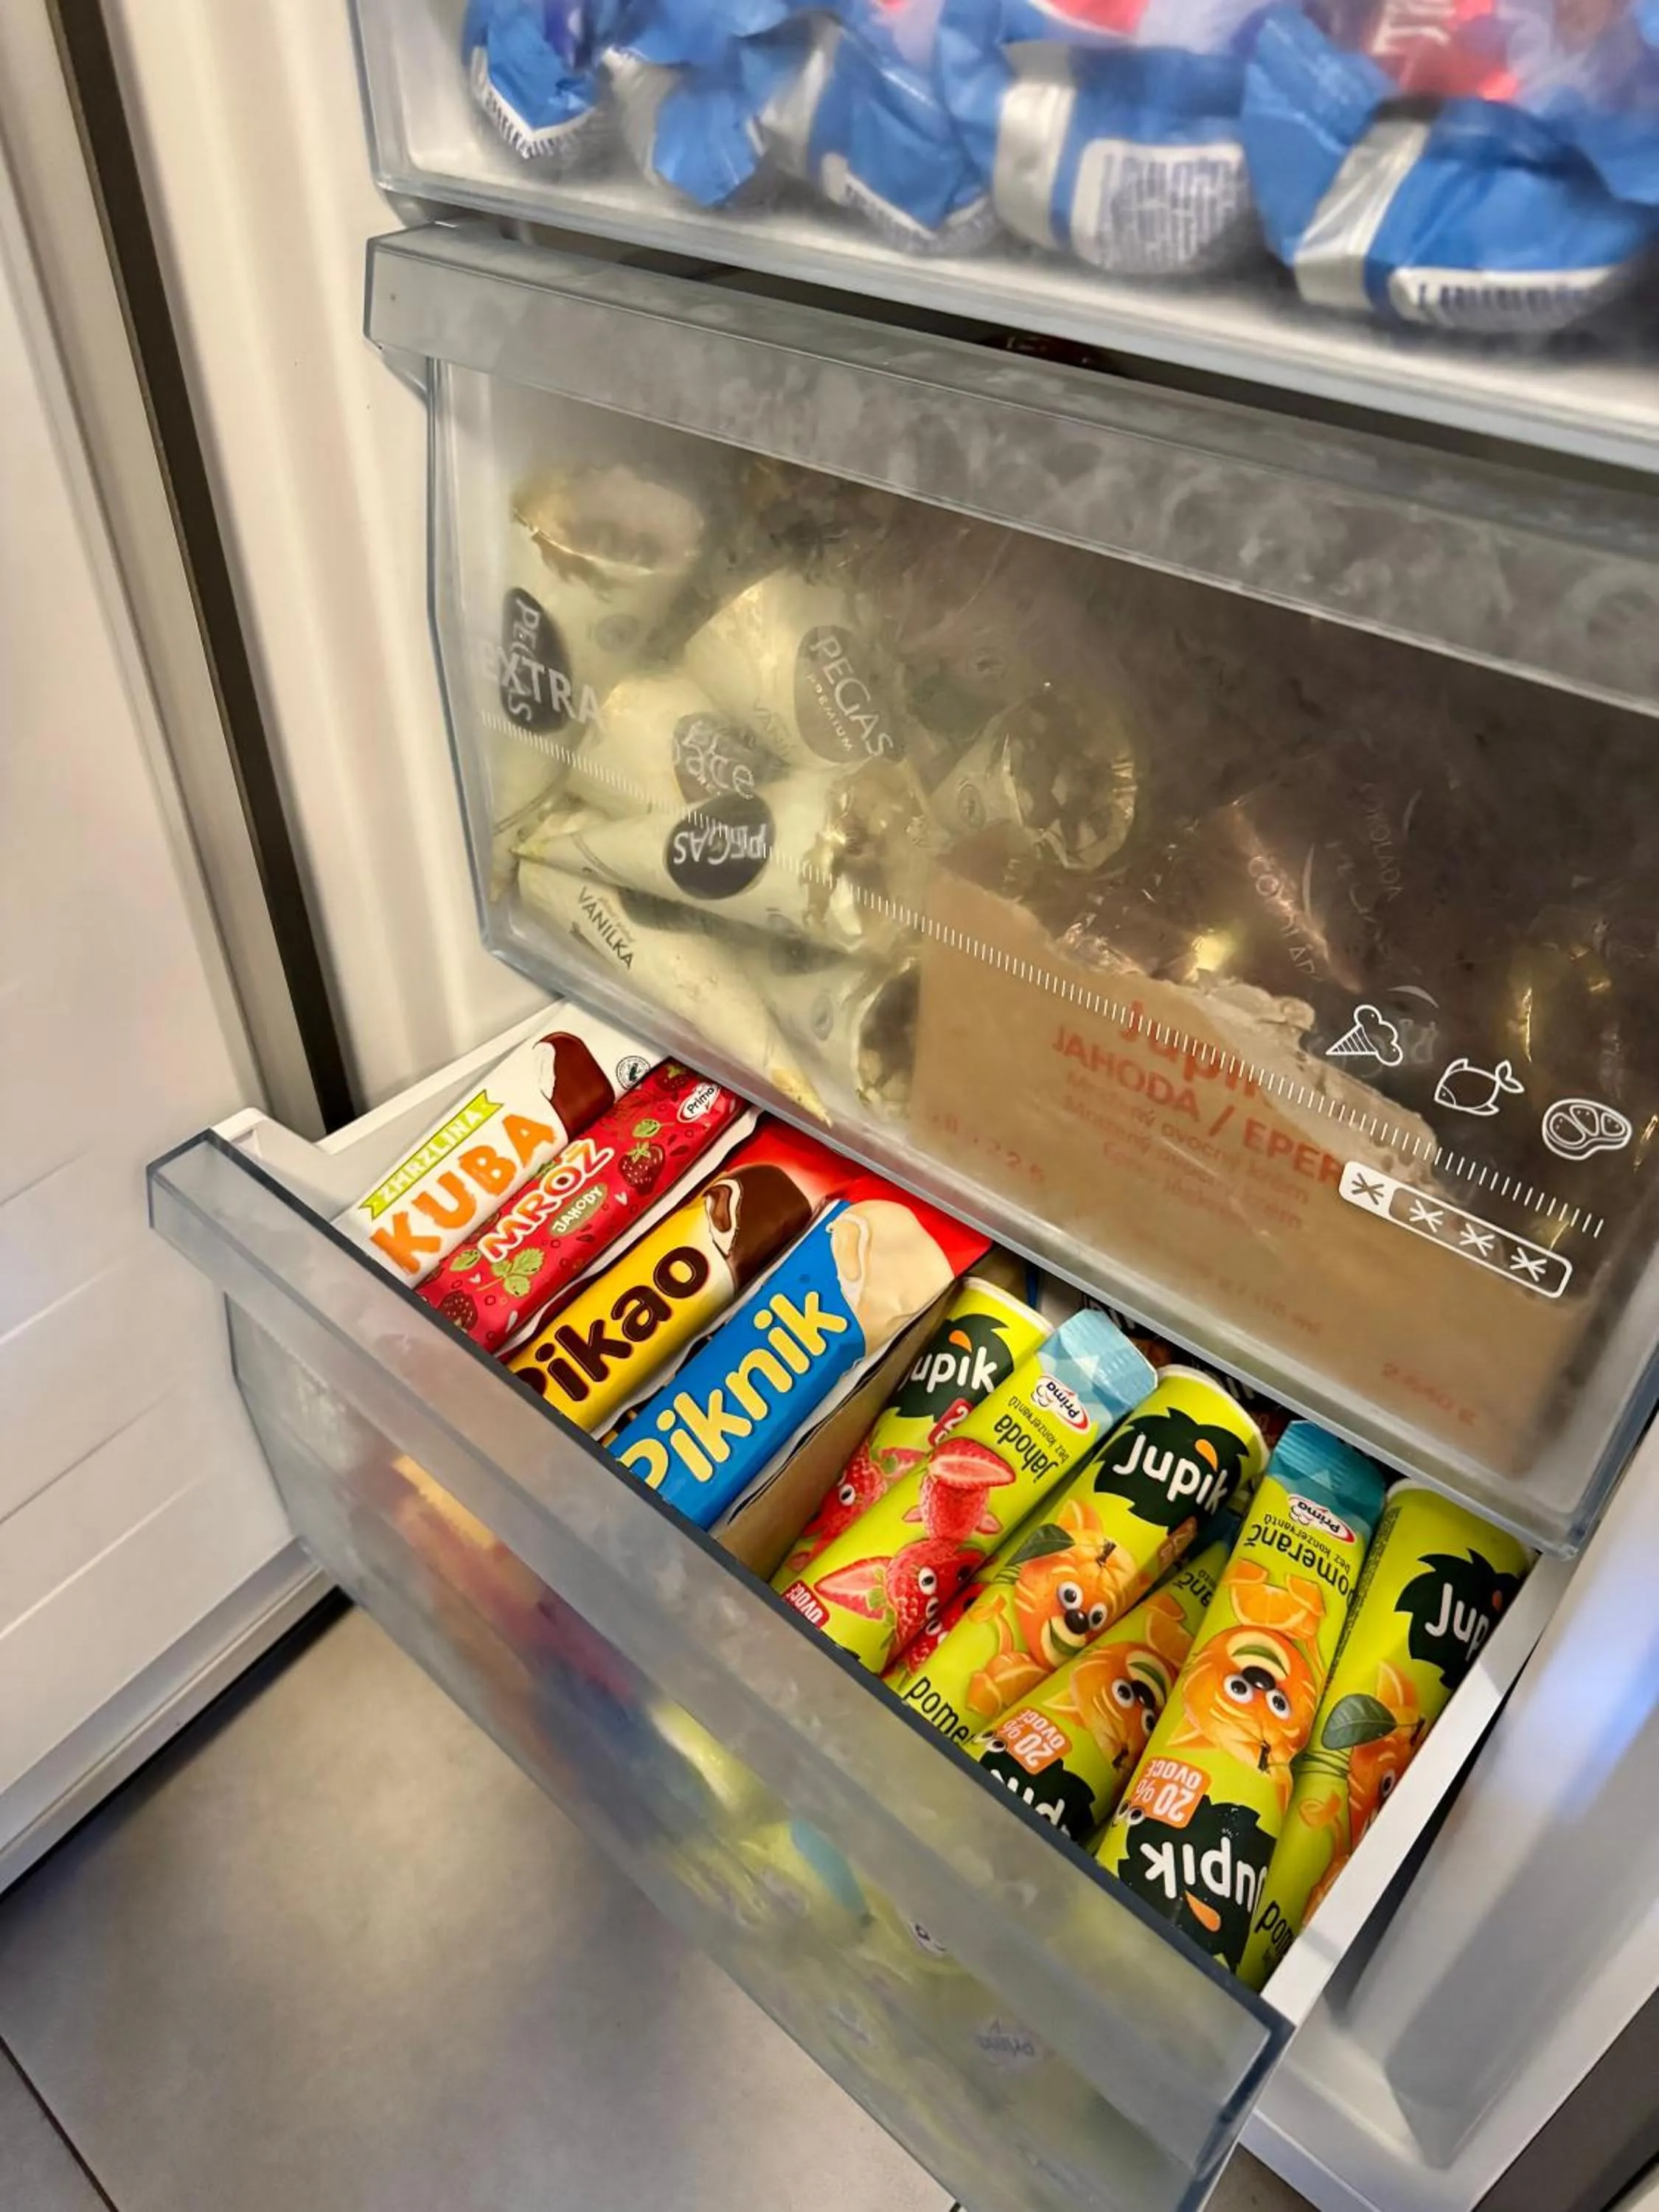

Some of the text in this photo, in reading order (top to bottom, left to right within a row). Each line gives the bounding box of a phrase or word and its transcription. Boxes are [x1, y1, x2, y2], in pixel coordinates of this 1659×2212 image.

[809, 634, 894, 757] PEGAS
[578, 885, 634, 971] VANILKA
[1052, 1025, 1200, 1123] JAHODA
[380, 1107, 484, 1203] ZMRZLINA
[369, 1113, 557, 1276] KUBA
[552, 1185, 603, 1233] JAHODY
[616, 1290, 848, 1489] Piknik
[1046, 1381, 1080, 1419] Prima
[993, 1413, 1059, 1484] jahoda
[1298, 1500, 1340, 1534] Prima
[1424, 1582, 1489, 1661] Jup
[1013, 1733, 1054, 1767] 20
[1145, 1759, 1203, 1790] OVOCE
[1152, 1784, 1195, 1823] 20
